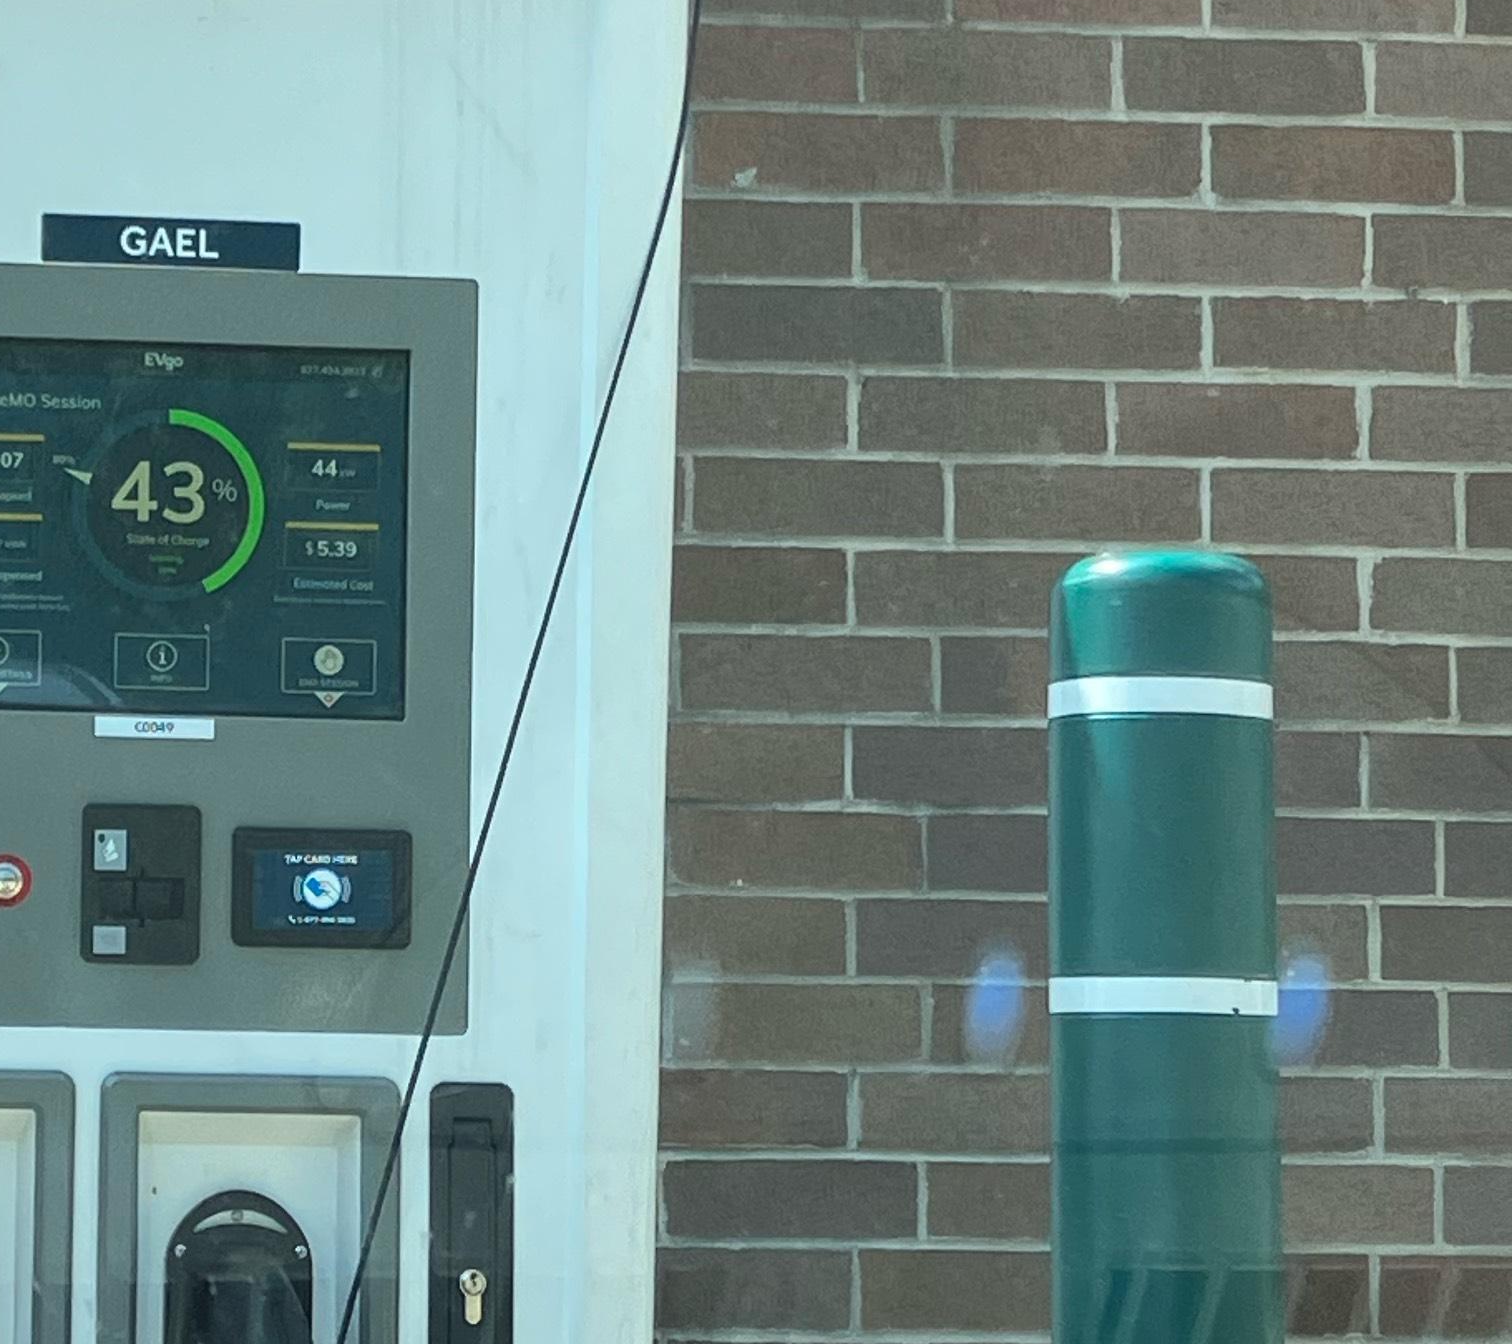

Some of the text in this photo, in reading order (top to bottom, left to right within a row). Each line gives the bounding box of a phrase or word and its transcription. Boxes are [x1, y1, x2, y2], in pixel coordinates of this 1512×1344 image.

[119, 224, 220, 260] GAEL
[144, 352, 184, 371] EVgo
[40, 393, 101, 409] Session
[311, 459, 338, 477] 44
[126, 533, 210, 550] State of Charge
[293, 577, 374, 592] Estimated Cost
